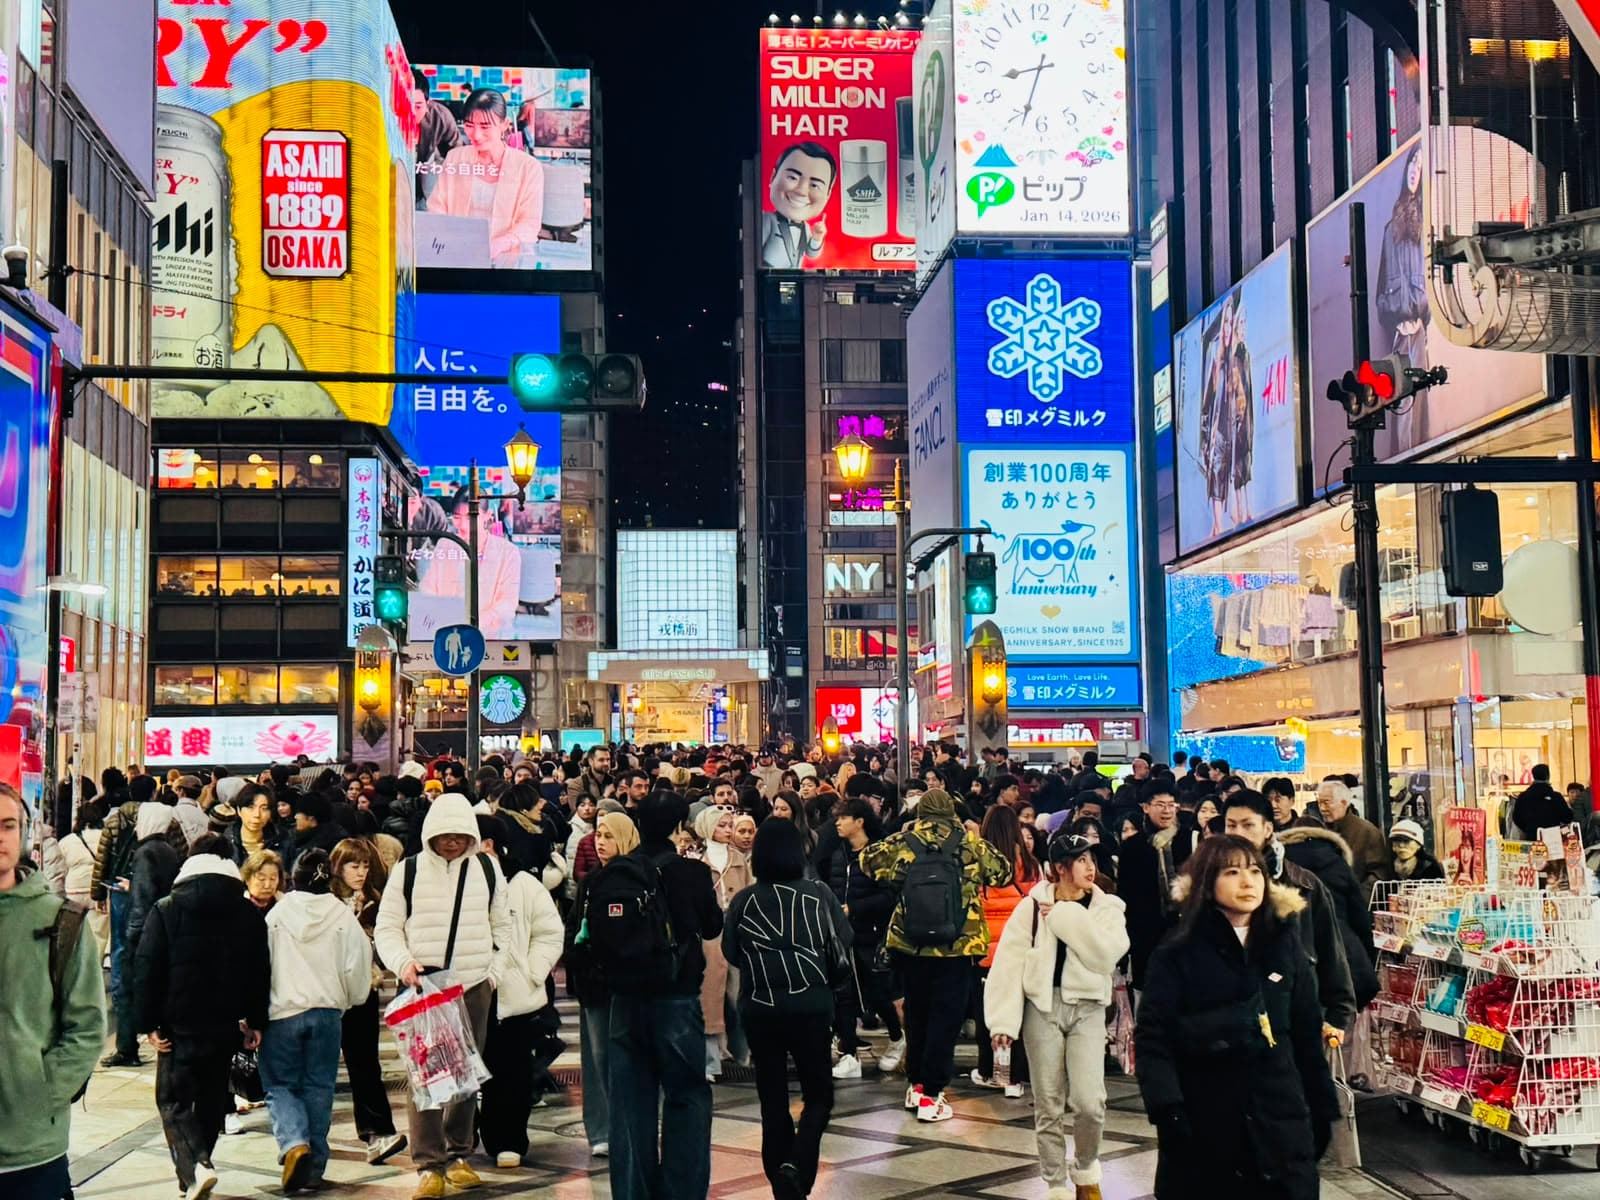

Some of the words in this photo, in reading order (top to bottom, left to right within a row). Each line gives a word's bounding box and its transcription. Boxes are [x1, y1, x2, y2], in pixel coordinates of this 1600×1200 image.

[1030, 3, 1050, 21] 12
[770, 55, 875, 80] SUPER
[770, 85, 886, 109] MILLION
[770, 113, 849, 136] HAIR
[1035, 115, 1049, 134] 6
[266, 143, 343, 178] ASAHI
[287, 178, 323, 193] since
[1023, 175, 1088, 202] ピップ
[265, 193, 343, 229] 1889
[1020, 209, 1049, 222] Jan
[267, 235, 343, 269] OSAKA
[414, 347, 478, 373] 人に、
[414, 385, 508, 413] 自由を。
[985, 406, 1108, 427] 雪印メグミルク
[914, 401, 946, 470] FANCL
[983, 461, 1113, 483] 創業100周年
[1001, 490, 1097, 510] ありがとう
[354, 488, 372, 549] 本場の味
[1022, 538, 1097, 561] 100th
[826, 562, 881, 591] NY
[1008, 582, 1098, 598] Anniversary
[1041, 626, 1070, 634] SNOW
[1072, 626, 1105, 634] BRAND
[1022, 684, 1117, 700] 雪印メグミルク
